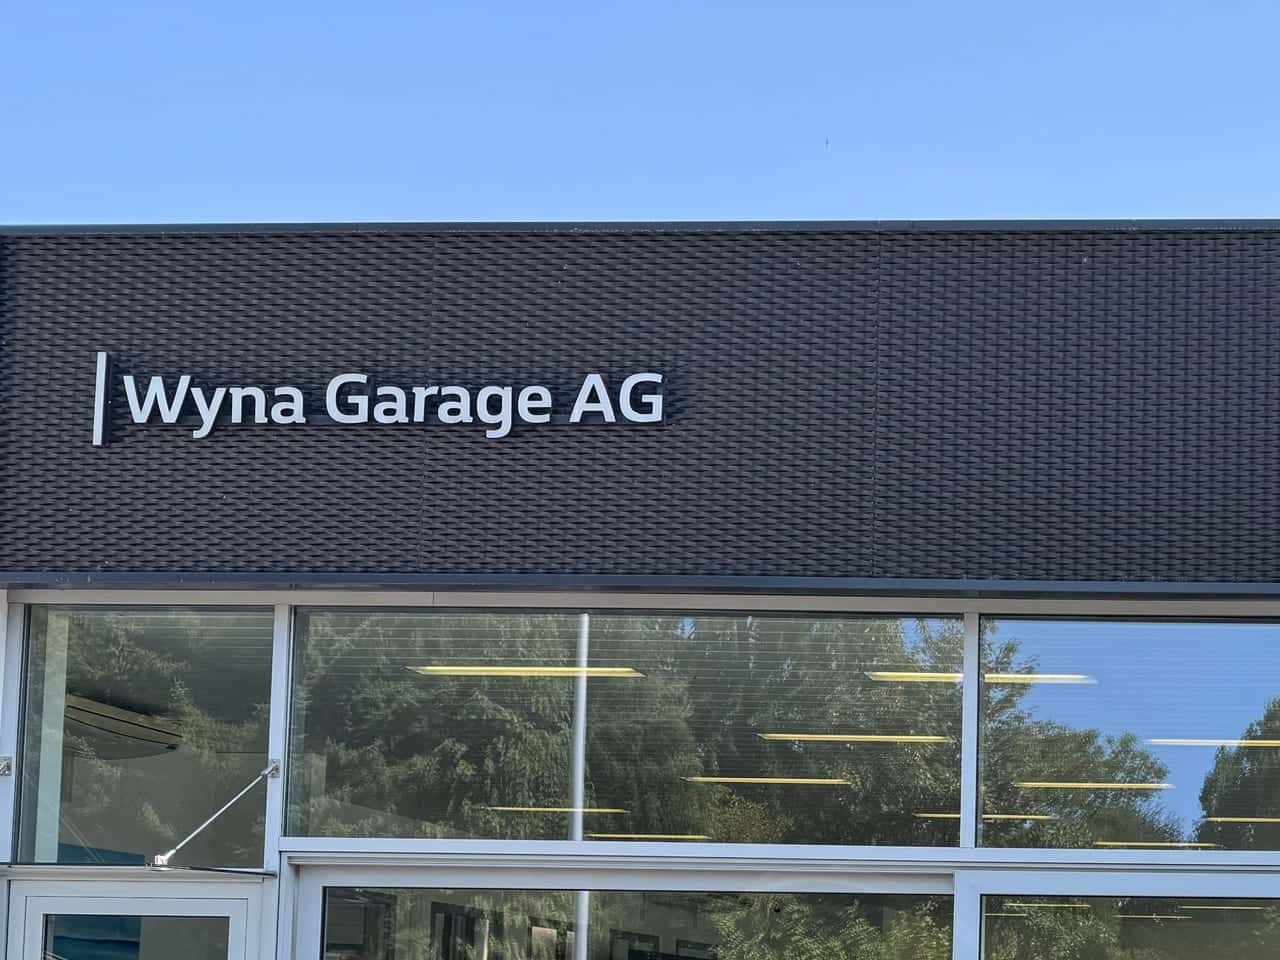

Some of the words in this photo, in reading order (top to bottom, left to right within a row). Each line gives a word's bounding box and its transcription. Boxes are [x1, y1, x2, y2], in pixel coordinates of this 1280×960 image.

[122, 373, 306, 440] Wyna
[324, 372, 553, 440] Garage
[568, 371, 664, 424] AG
